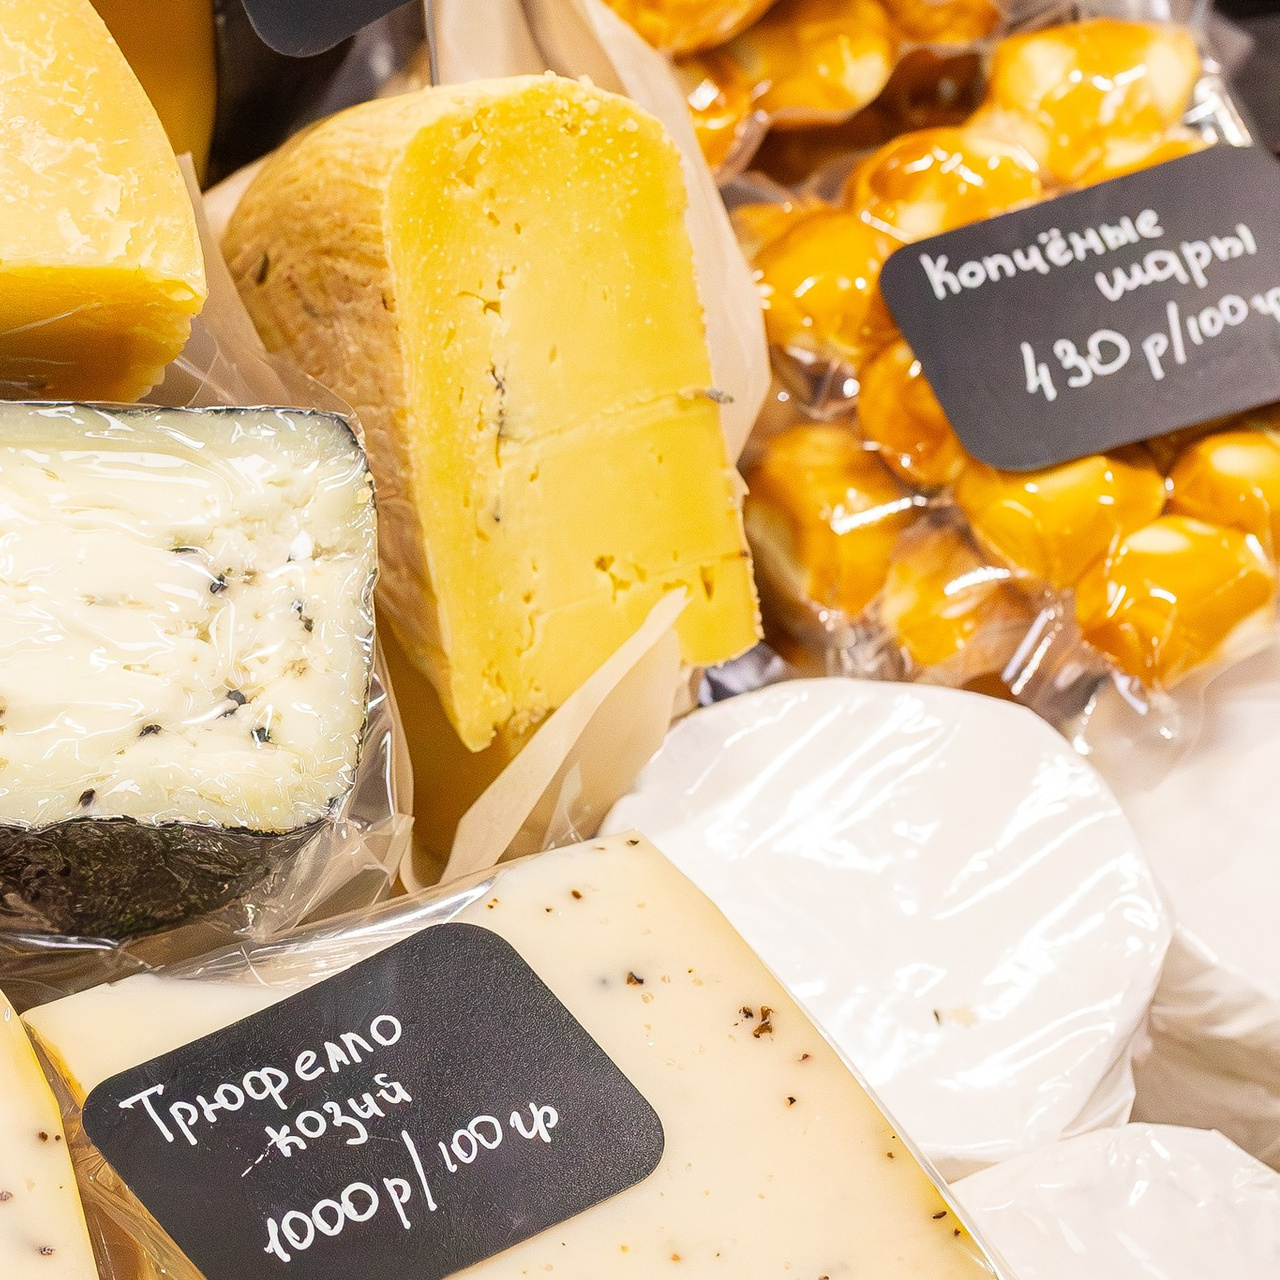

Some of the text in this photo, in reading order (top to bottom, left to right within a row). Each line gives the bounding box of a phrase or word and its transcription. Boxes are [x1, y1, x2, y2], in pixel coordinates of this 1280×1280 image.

[920, 208, 1165, 300] Копчёные
[1094, 222, 1258, 302] шары
[119, 1014, 403, 1146] Трюфелло
[262, 1073, 412, 1158] козий
